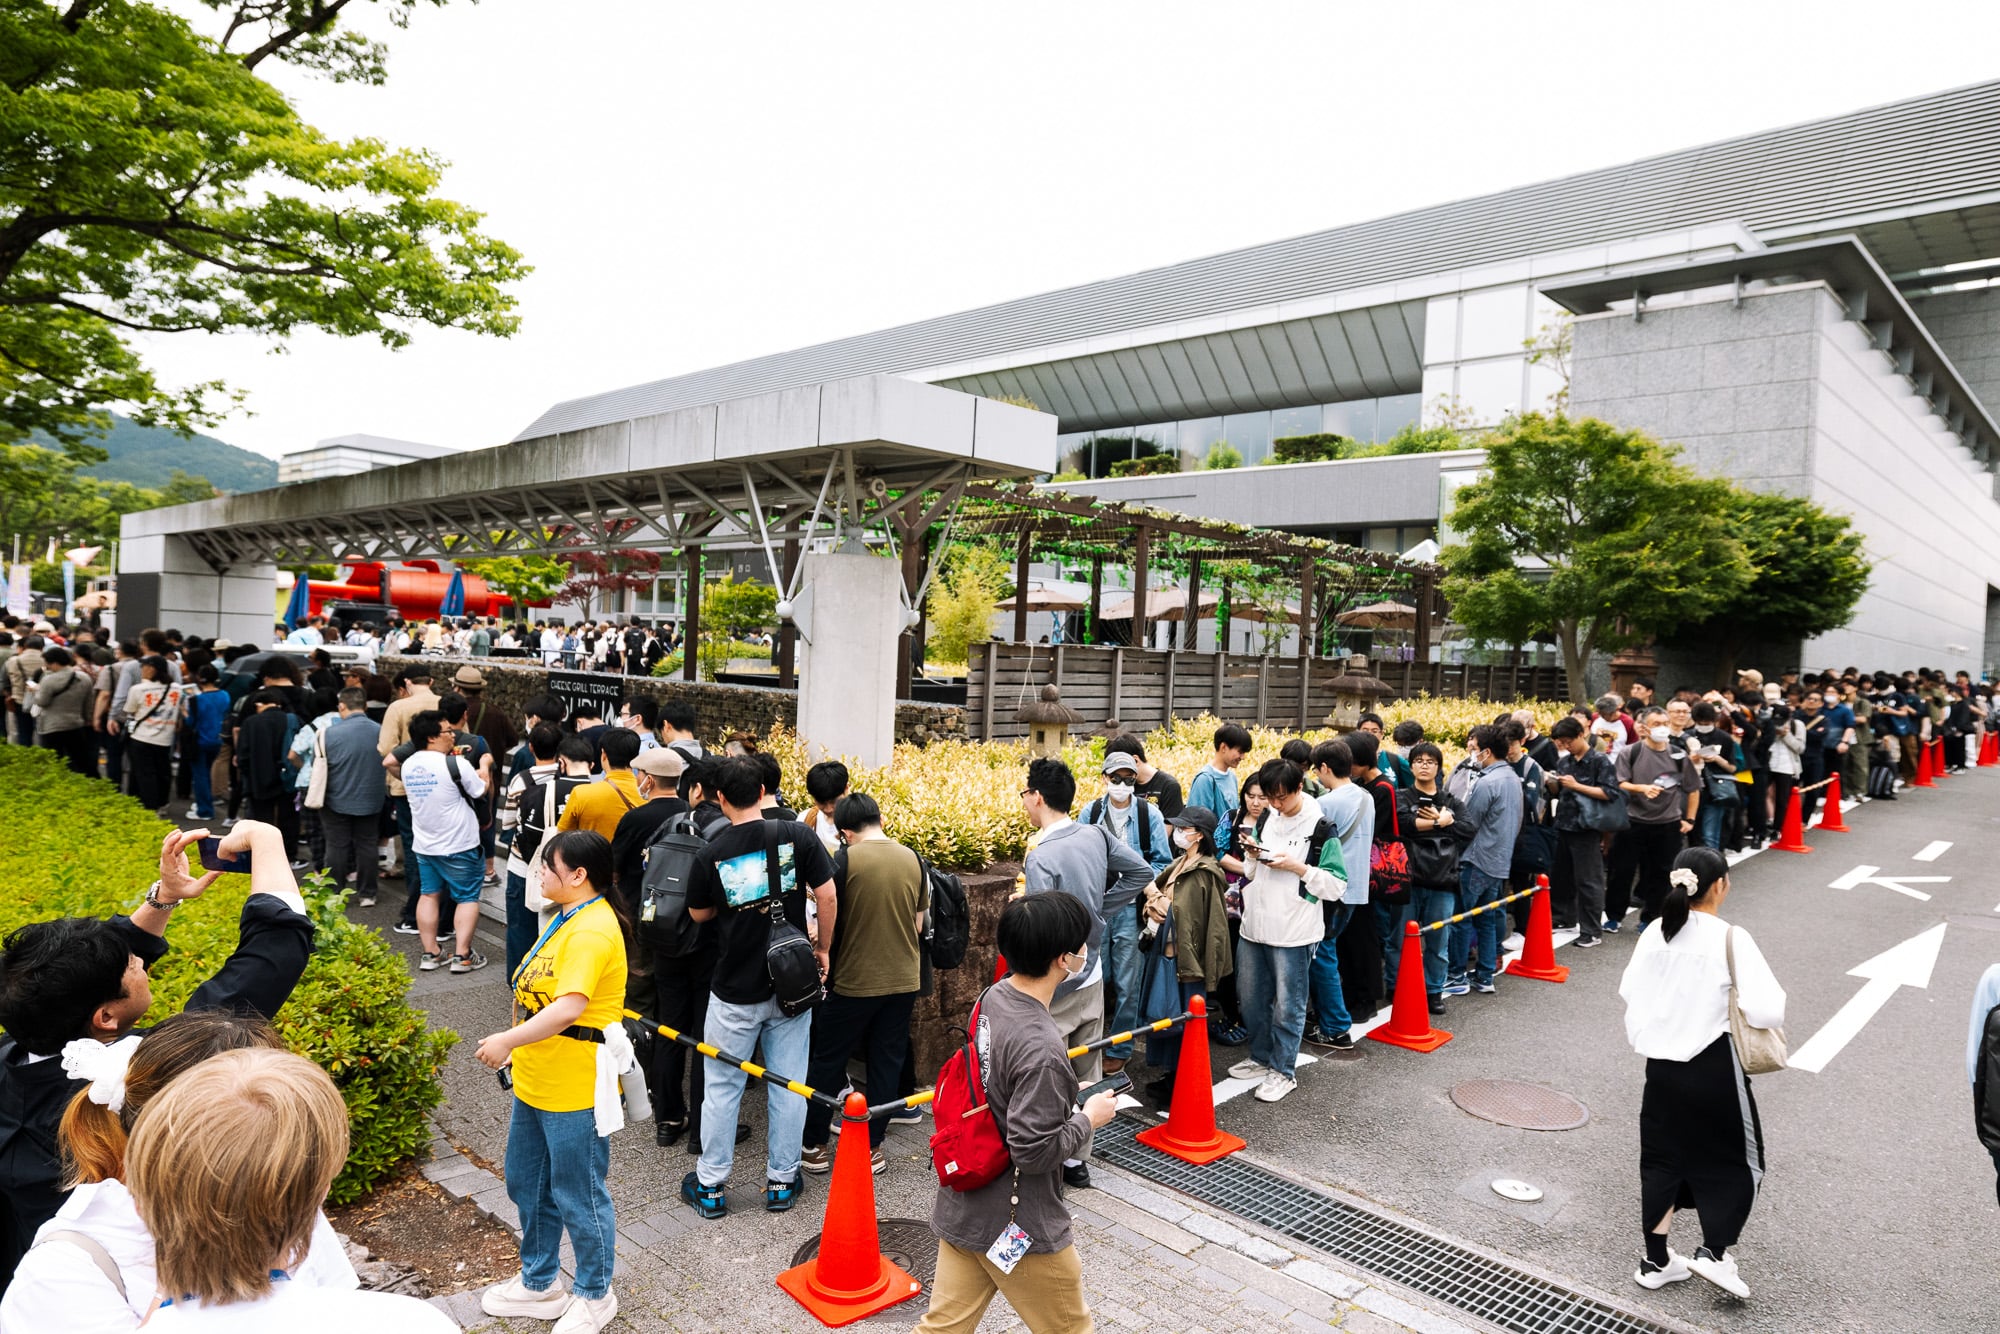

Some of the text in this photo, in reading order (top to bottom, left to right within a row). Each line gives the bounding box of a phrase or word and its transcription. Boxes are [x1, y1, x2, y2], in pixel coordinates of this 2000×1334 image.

[551, 680, 619, 696] CHEESE GRILL TERRACE
